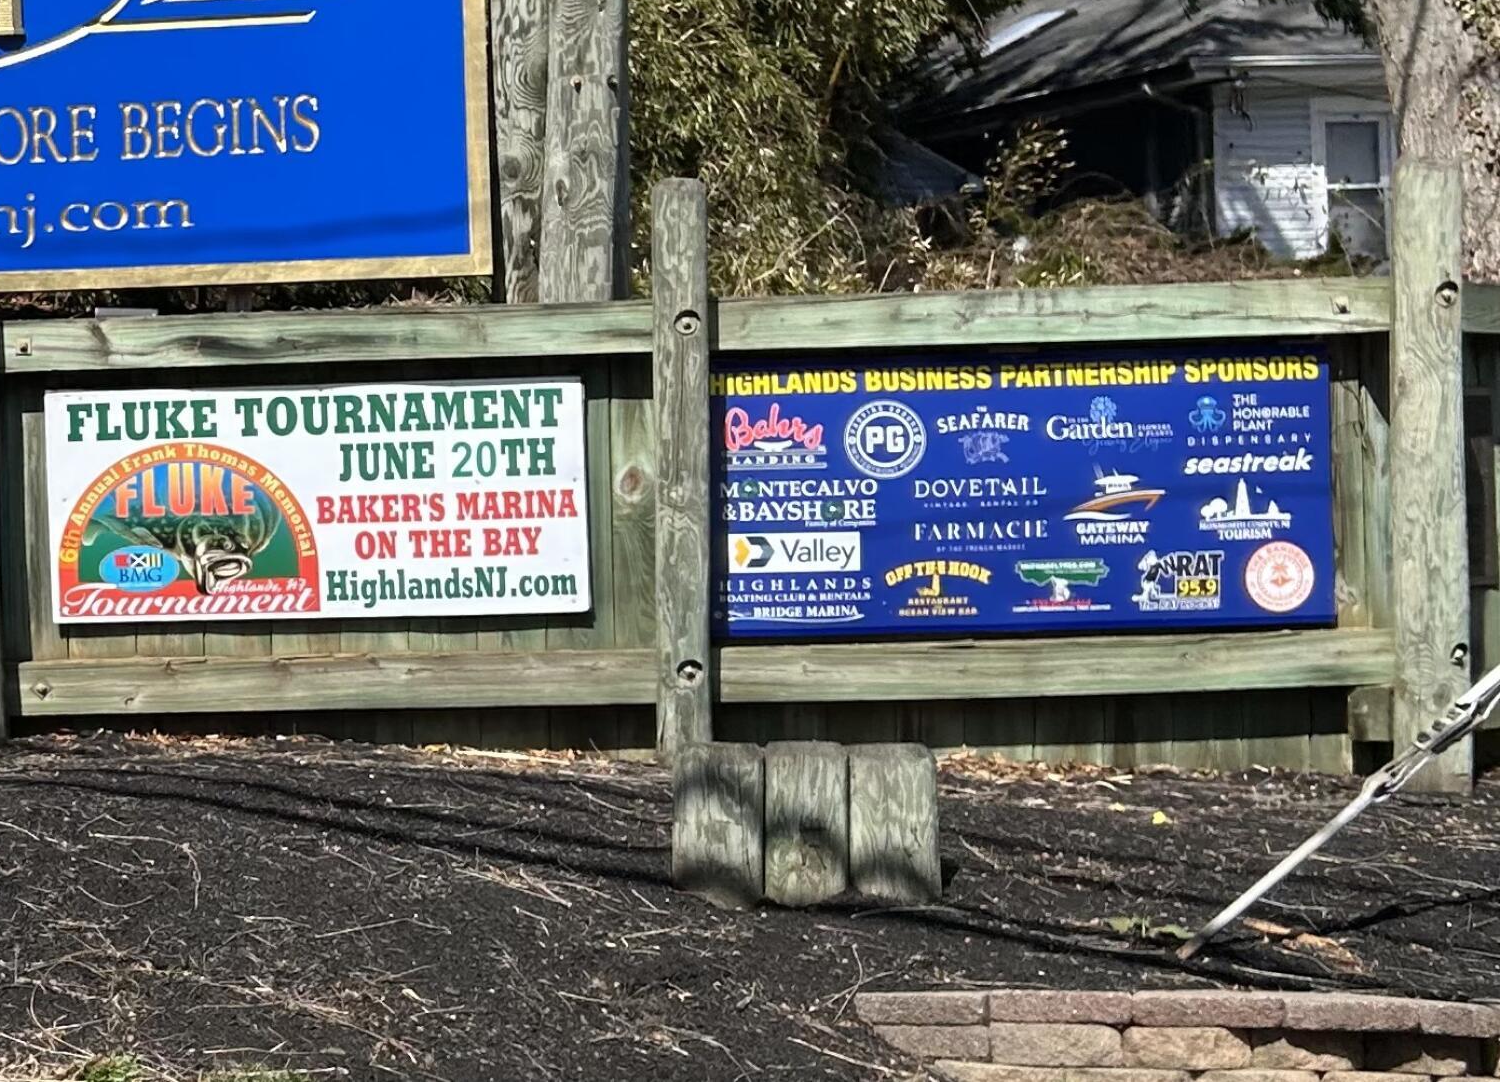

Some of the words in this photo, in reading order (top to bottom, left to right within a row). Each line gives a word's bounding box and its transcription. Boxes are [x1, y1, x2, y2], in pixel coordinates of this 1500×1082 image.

[119, 96, 320, 162] BEGINS
[710, 369, 856, 396] HIGHLANDS
[864, 365, 992, 392] BUSINESS
[1000, 360, 1176, 388] PARTNERSHIP
[1184, 355, 1320, 383] SPONSORS
[1232, 393, 1257, 407] THE
[67, 399, 217, 442] FLUKE
[235, 388, 563, 437] TOURNAMENT
[937, 412, 1029, 434] SEAFARER
[1233, 406, 1310, 419] HONORABLE
[1046, 415, 1133, 440] Garden
[1233, 420, 1273, 432] PLANT
[866, 425, 905, 453] PG
[1187, 433, 1311, 446] DISPENSARY
[339, 440, 434, 481] JUNE
[451, 437, 556, 479] 20TH
[731, 454, 816, 466] LANDING
[1184, 447, 1313, 474] seastreak
[115, 462, 256, 518] FLUKE
[914, 476, 1047, 498] DOVETAIL
[59, 529, 81, 563] 6th
[73, 471, 121, 527] Annual
[121, 445, 177, 474] Frank
[183, 444, 258, 477] Thomas
[259, 475, 315, 557] Memorial
[317, 491, 445, 525] BAKER'S
[456, 489, 578, 520] MARINA
[915, 519, 1048, 541] FARMACIE
[1076, 521, 1149, 534] GATEWAY
[1218, 528, 1272, 540] TOURISM
[355, 531, 397, 559] ON
[409, 529, 471, 558] THE
[483, 526, 542, 555] BAY
[1081, 534, 1145, 545] MARINA
[780, 538, 855, 569] Valley
[119, 567, 163, 583] BMG
[720, 577, 871, 591] HIGHLANDS
[885, 564, 912, 587] OFF
[914, 561, 946, 576] THE
[949, 561, 992, 585] HOOK
[326, 567, 578, 607] HighlandsNJ.com
[775, 593, 805, 602] CLUB
[819, 591, 871, 601] RENTALS
[1178, 579, 1217, 598] 95.9
[62, 583, 318, 616] Tournament
[754, 605, 803, 618] BRIDGE
[806, 605, 859, 617] MARINA
